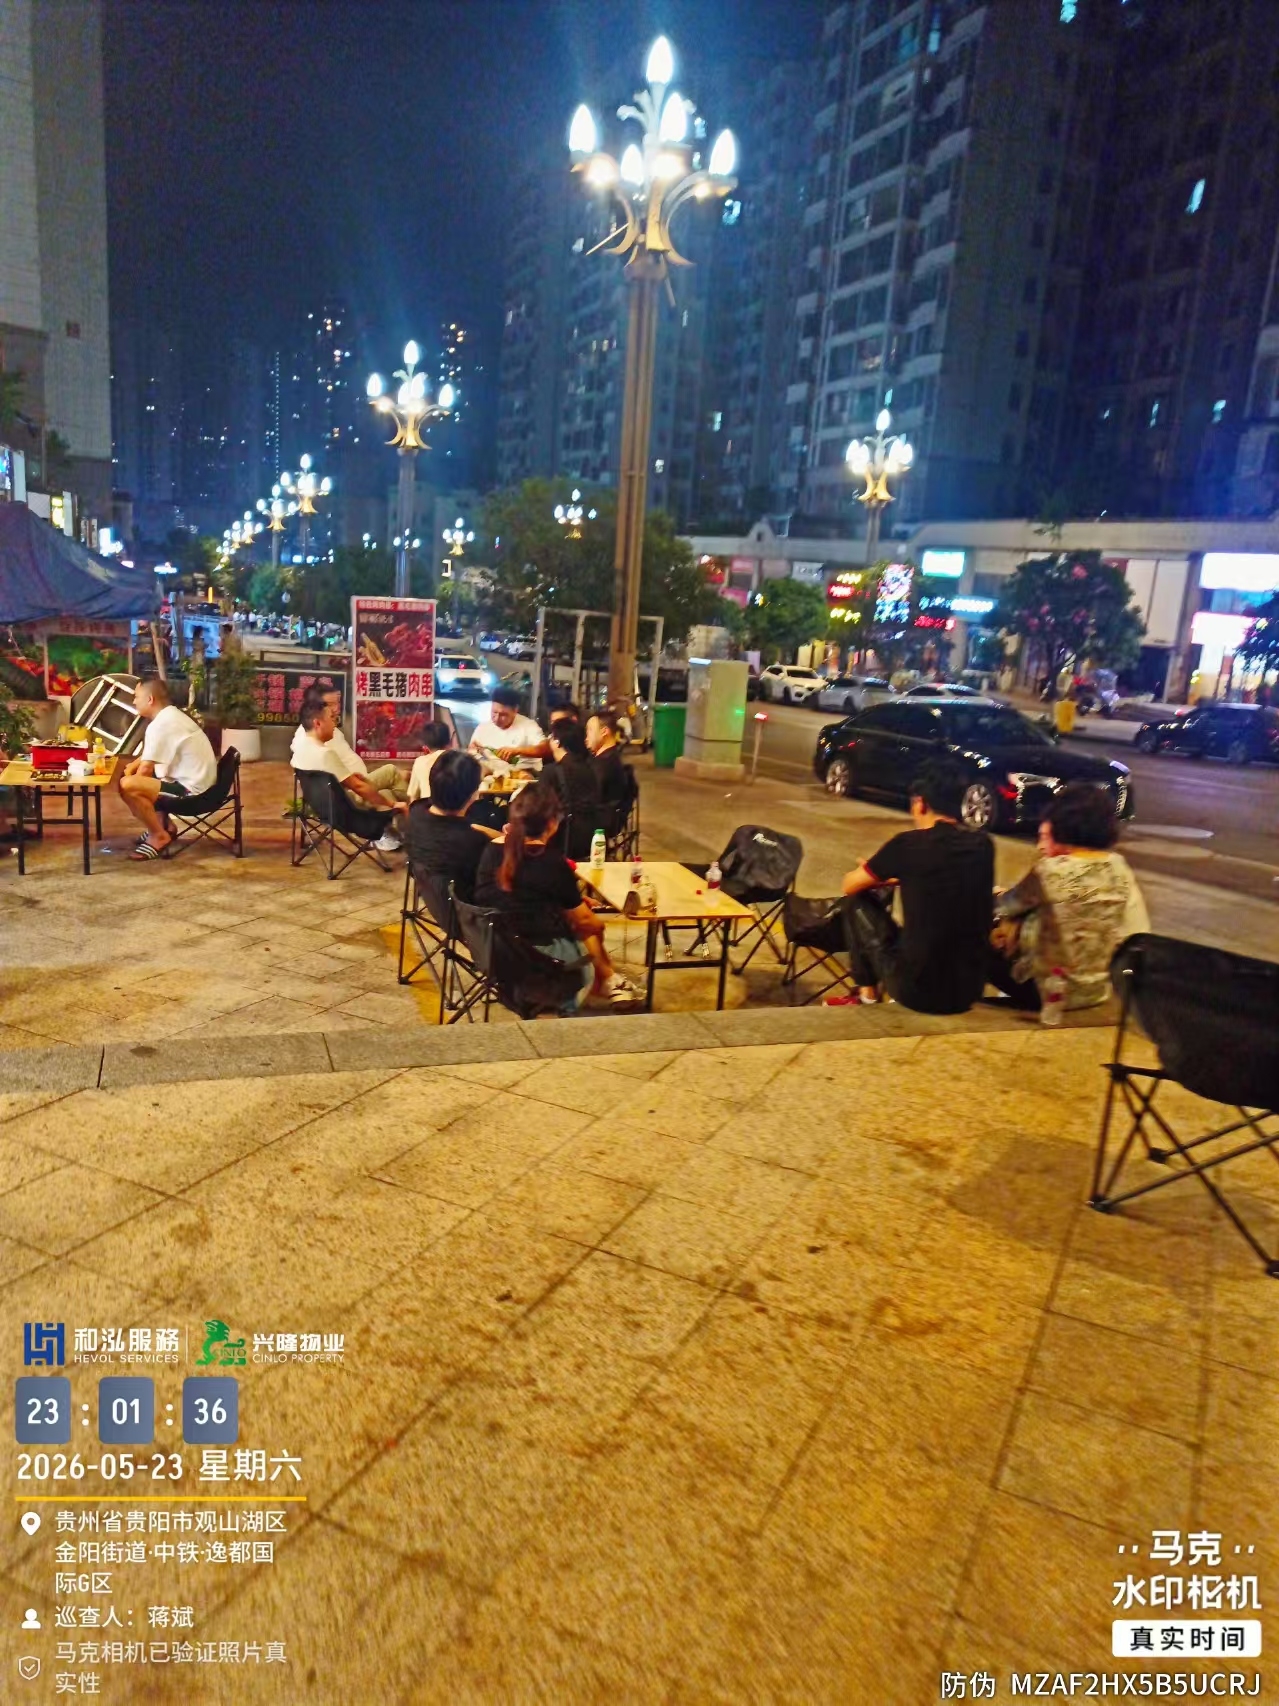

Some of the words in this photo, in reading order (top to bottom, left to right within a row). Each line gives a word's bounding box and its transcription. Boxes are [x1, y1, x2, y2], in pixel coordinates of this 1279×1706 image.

[356, 671, 433, 698] 烤黑毛猪肉串
